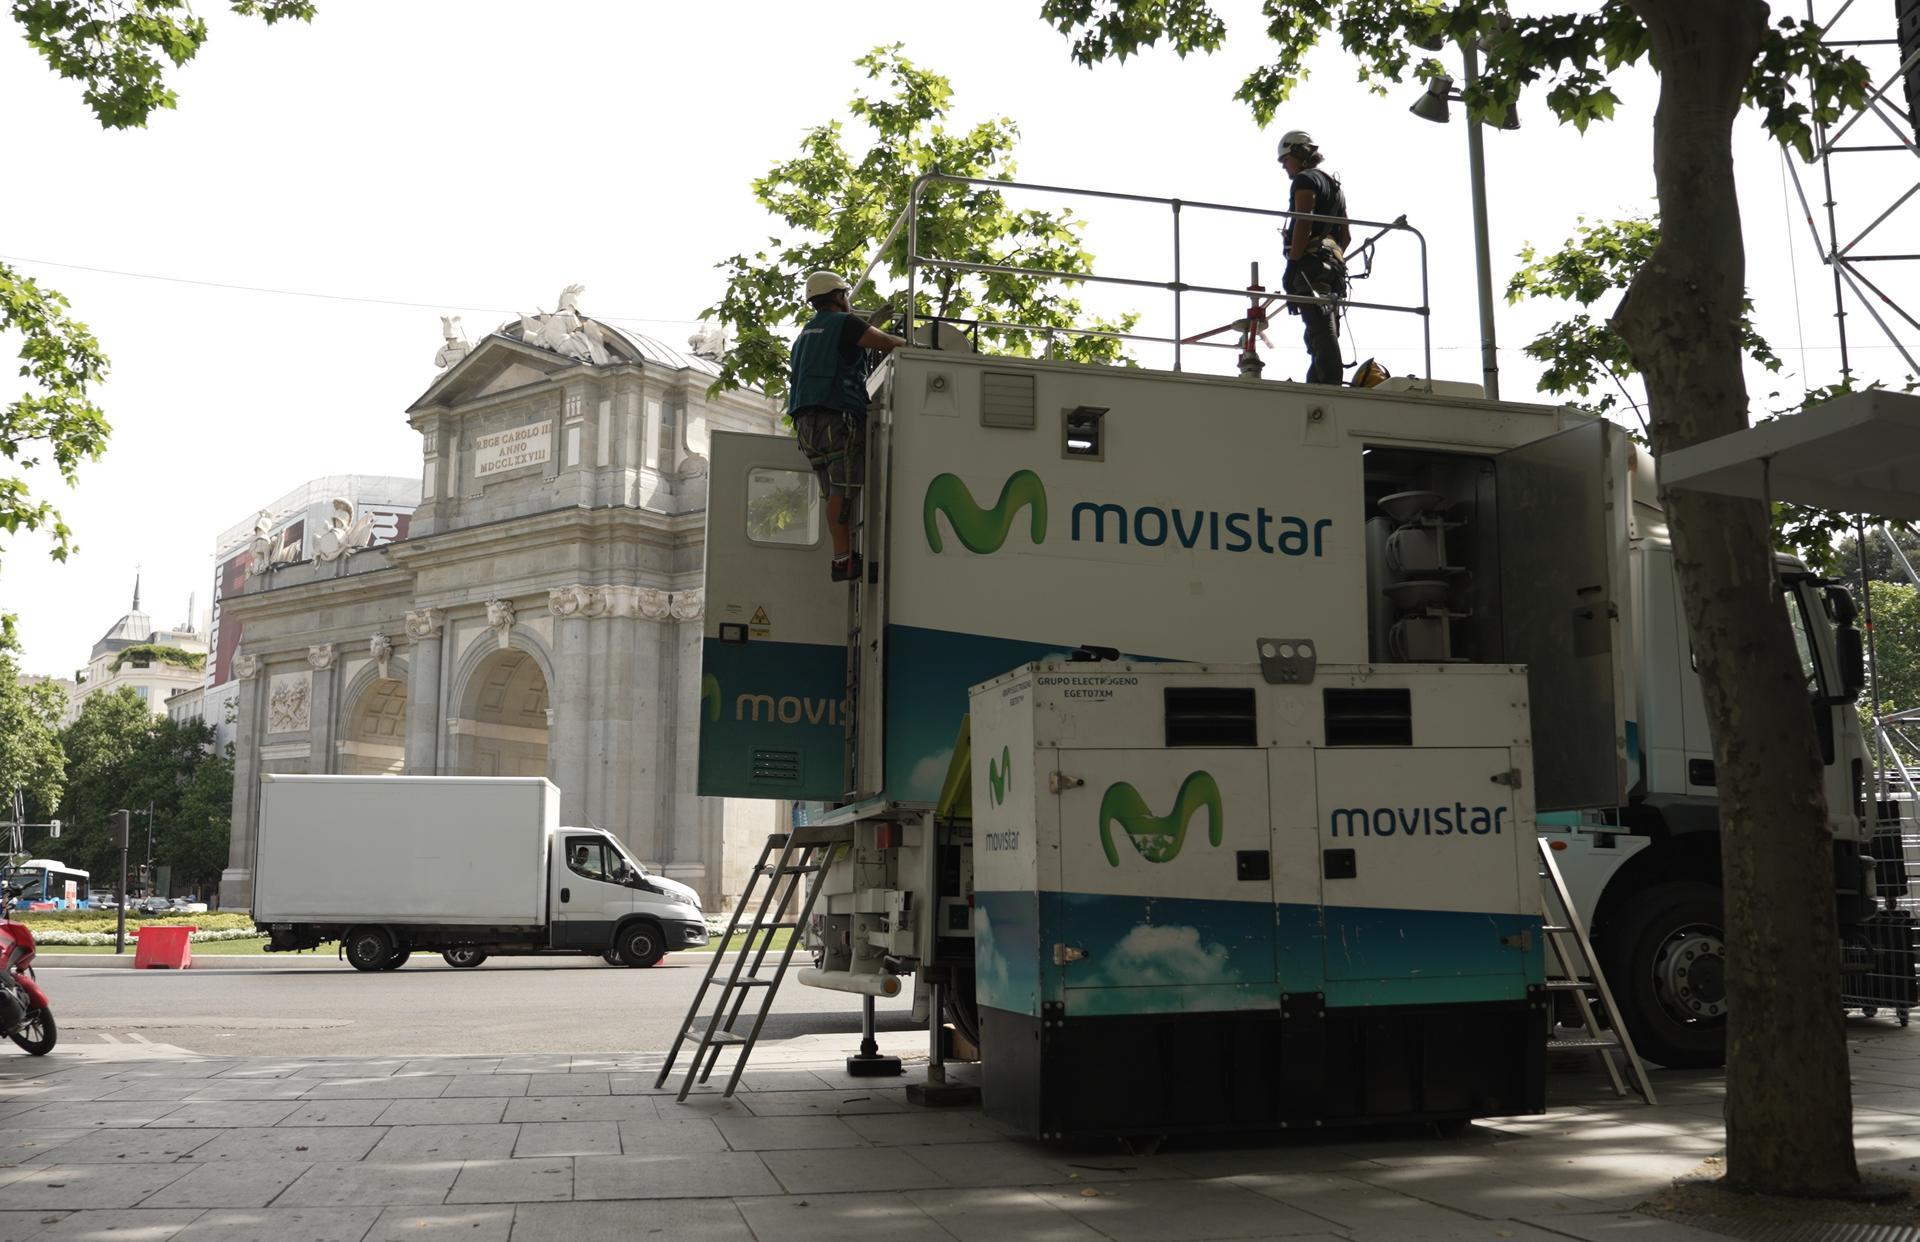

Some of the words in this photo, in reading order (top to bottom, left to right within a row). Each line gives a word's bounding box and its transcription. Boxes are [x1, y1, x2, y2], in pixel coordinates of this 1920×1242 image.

[502, 427, 539, 443] CAROLO
[541, 423, 552, 435] III
[498, 442, 527, 457] ANNO
[480, 450, 546, 473] MDCCLXXVIII
[1071, 501, 1332, 557] movistar
[1038, 677, 1070, 686] GRUPO
[1064, 689, 1113, 698] EGET07XM
[1331, 802, 1507, 837] movistar
[986, 828, 1020, 851] movistar
